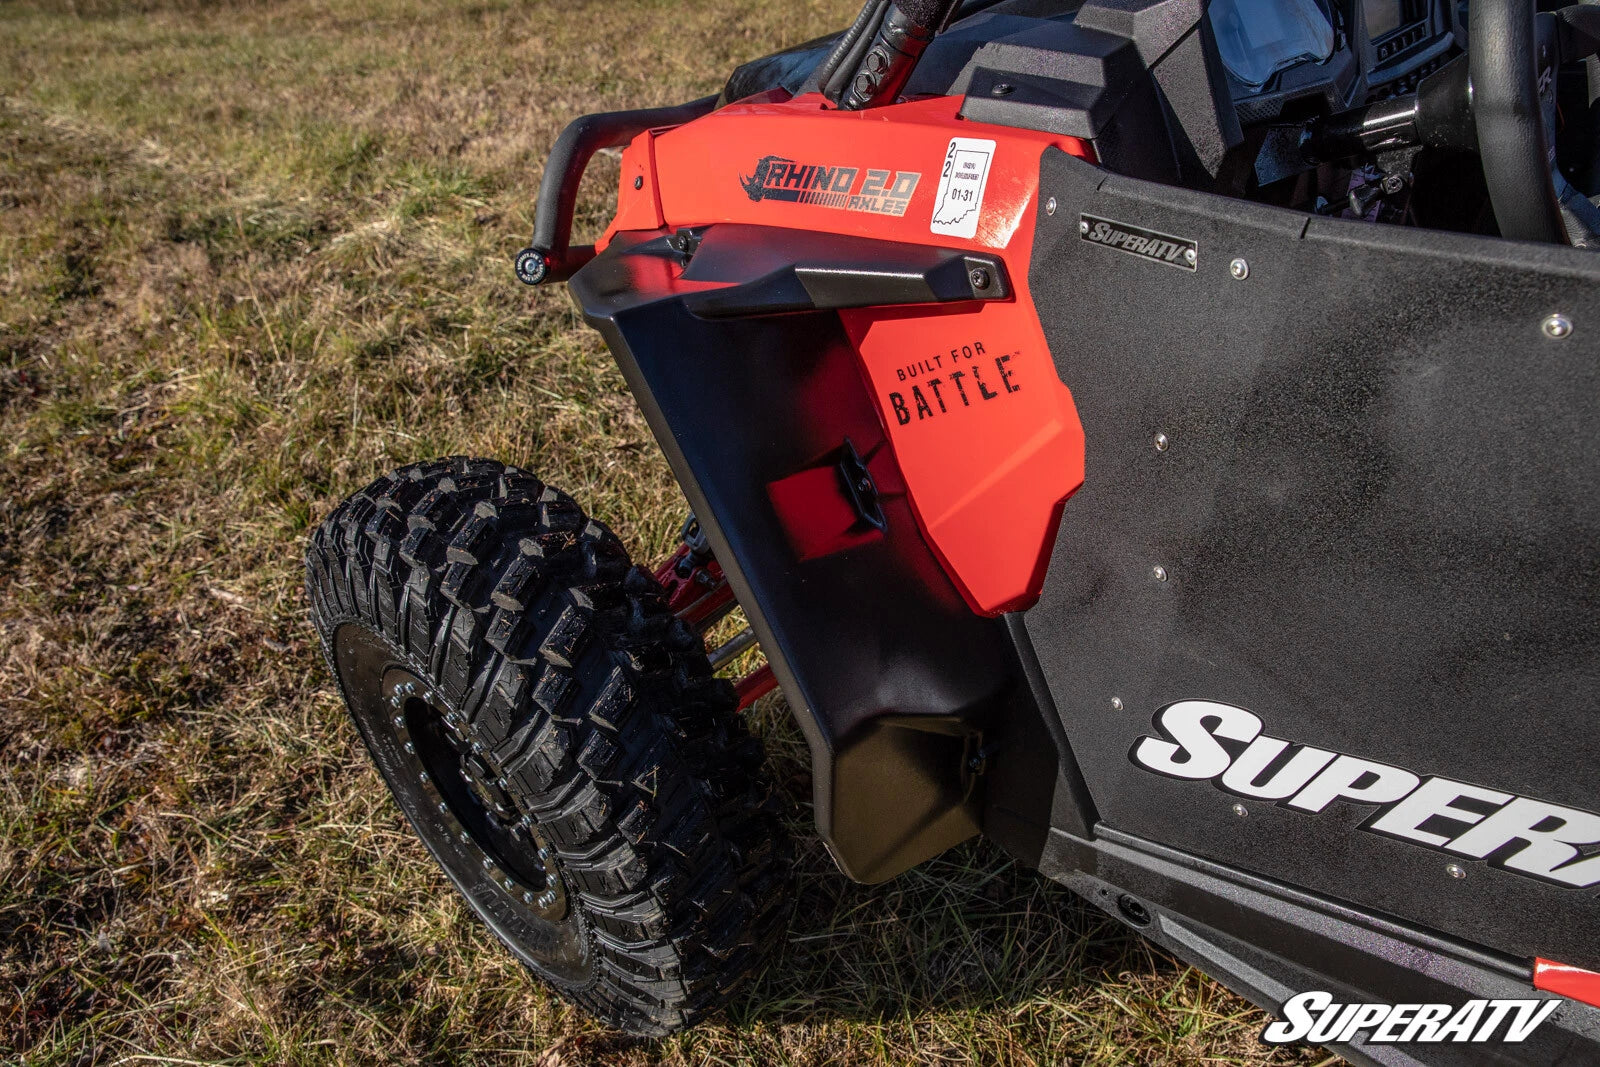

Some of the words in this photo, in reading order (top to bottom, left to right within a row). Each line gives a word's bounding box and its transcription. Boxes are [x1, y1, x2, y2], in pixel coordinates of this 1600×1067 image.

[765, 162, 859, 194] RHINO
[860, 168, 922, 200] 2.0
[951, 188, 974, 202] 01-31
[847, 195, 908, 216] AXLES
[1088, 221, 1187, 261] SUPERATV
[896, 355, 943, 382] BUILT
[950, 341, 986, 363] FOR
[888, 354, 1020, 426] BATTLE
